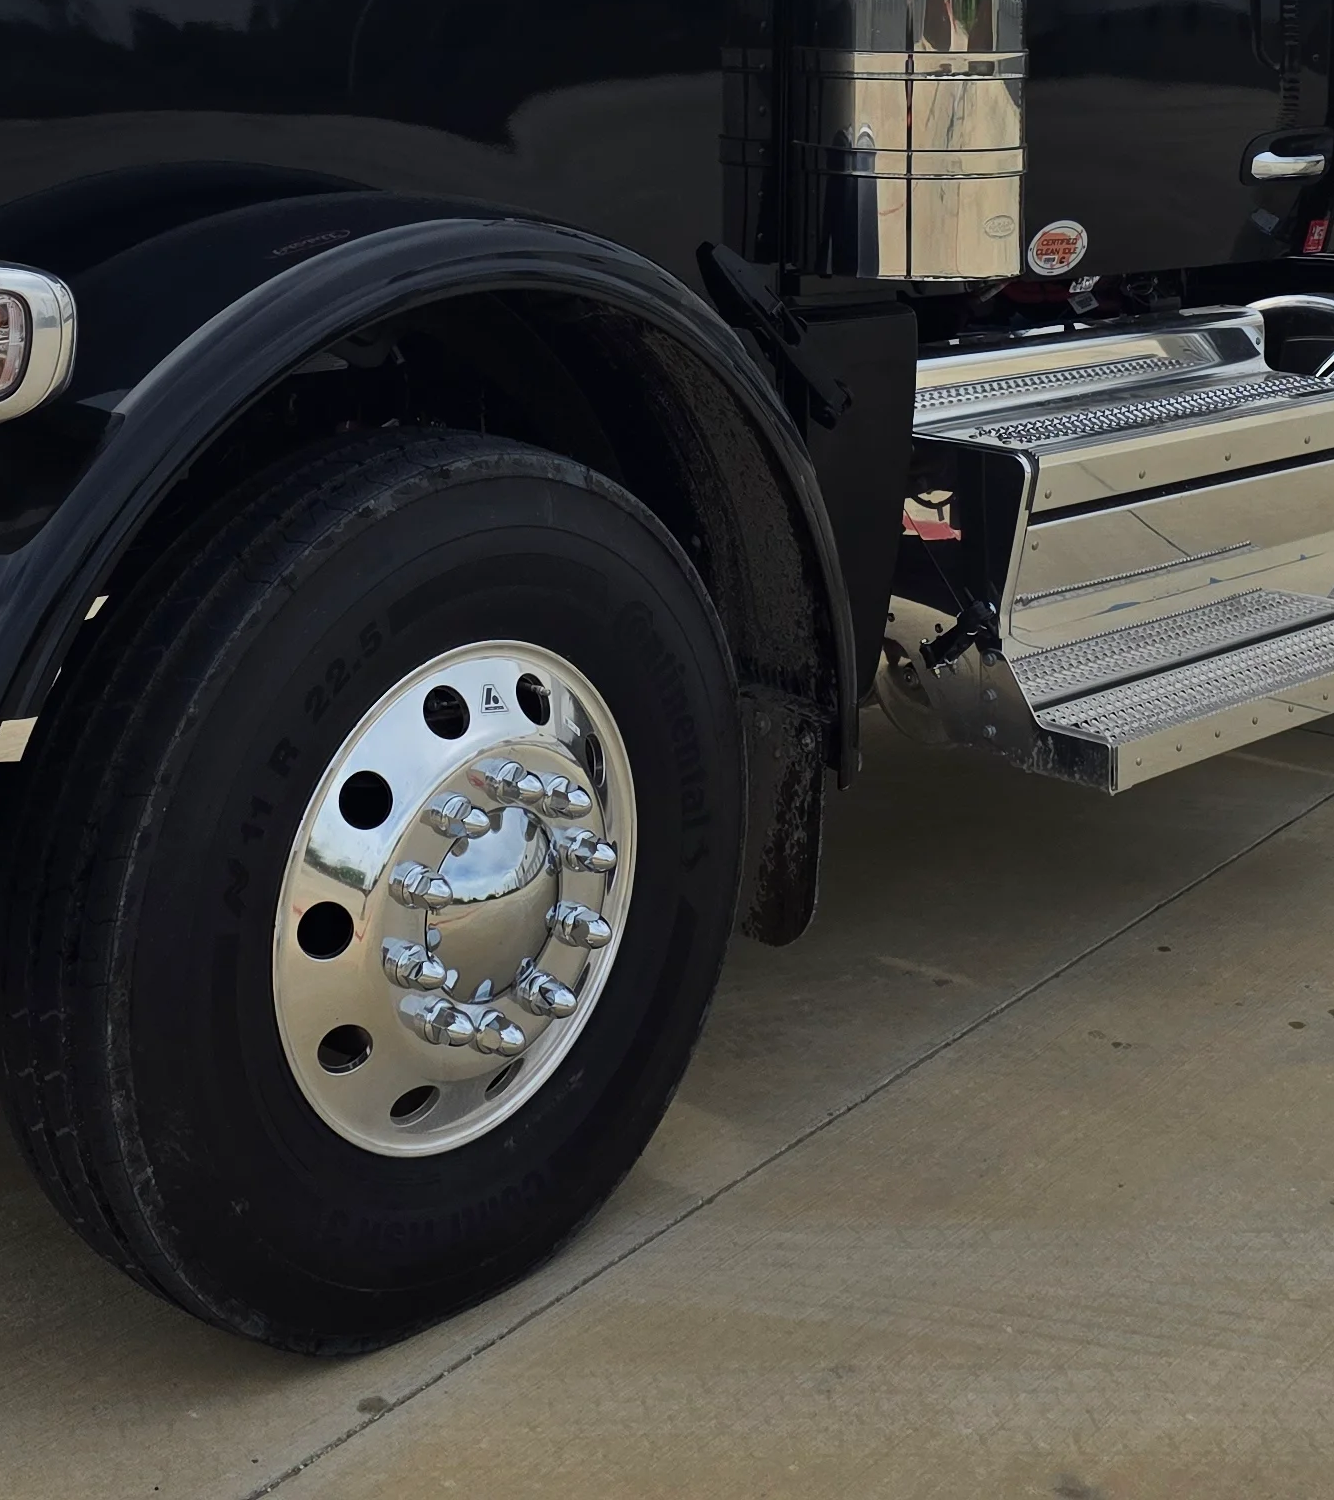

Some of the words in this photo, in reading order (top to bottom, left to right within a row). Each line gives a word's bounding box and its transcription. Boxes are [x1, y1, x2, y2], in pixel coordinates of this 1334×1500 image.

[1041, 238, 1078, 247] CERTIFIED
[1036, 248, 1061, 256] CLEAN
[1062, 247, 1079, 255] IDLE
[304, 619, 384, 725] 22.5
